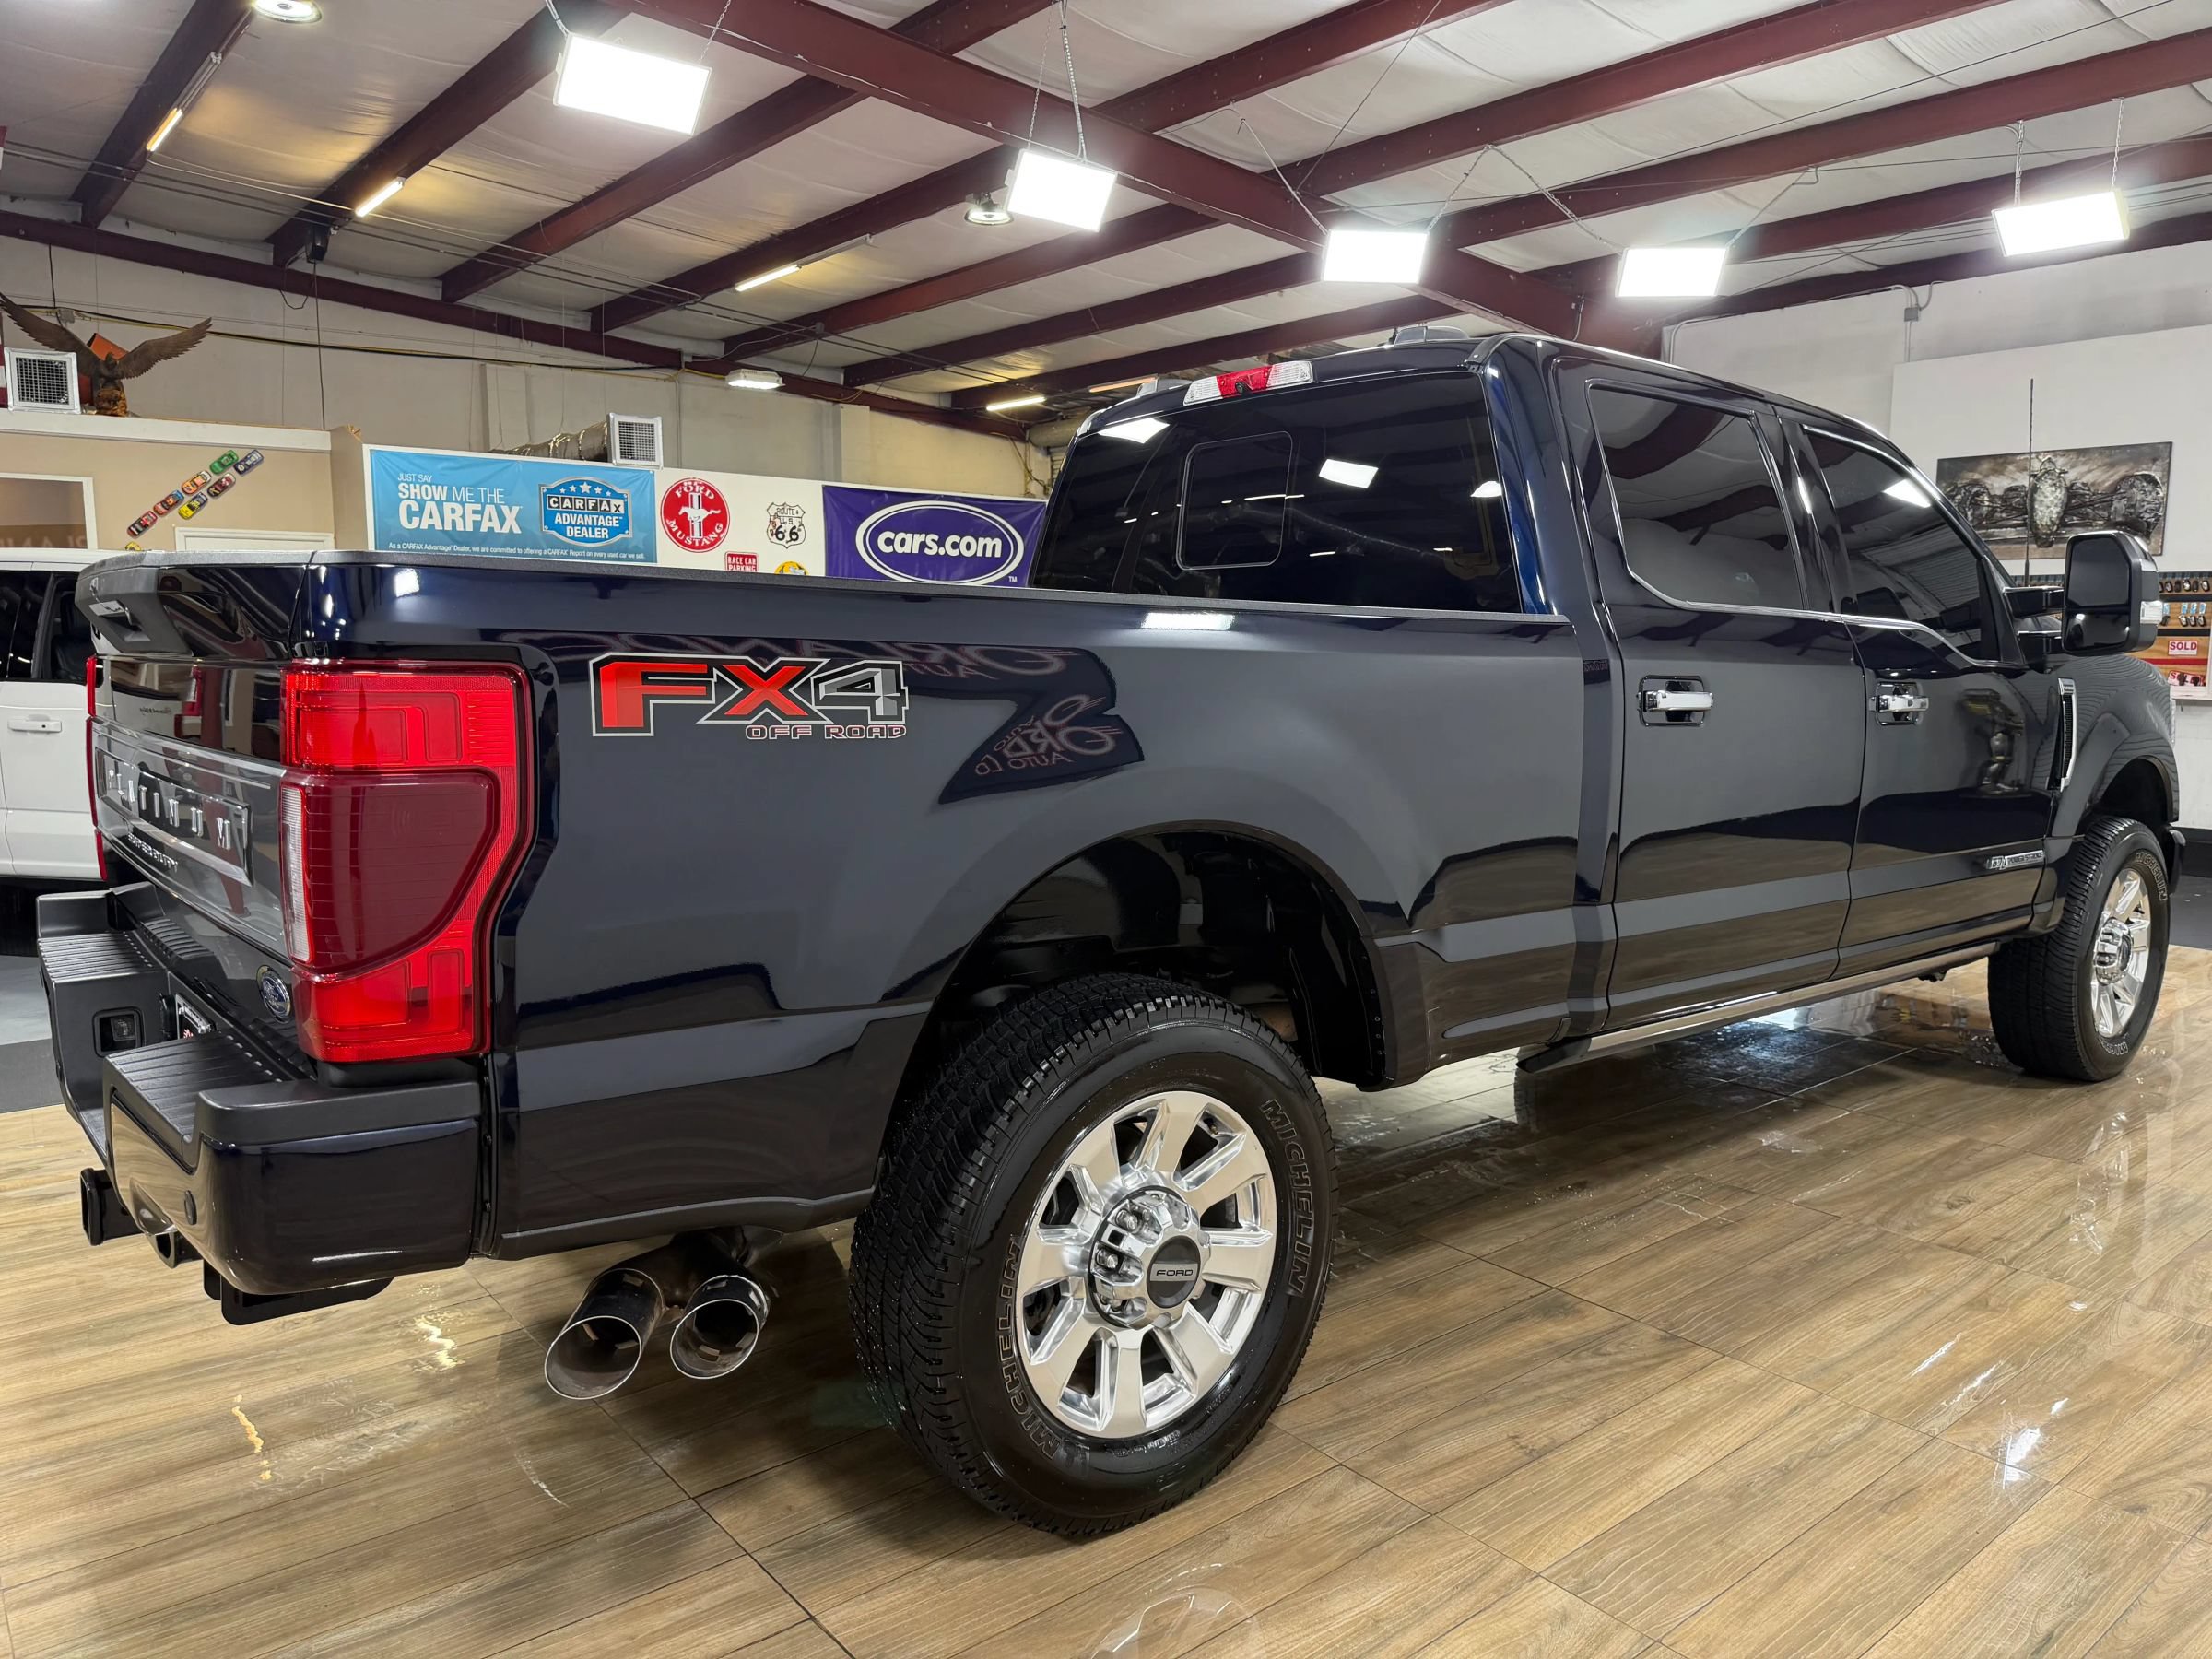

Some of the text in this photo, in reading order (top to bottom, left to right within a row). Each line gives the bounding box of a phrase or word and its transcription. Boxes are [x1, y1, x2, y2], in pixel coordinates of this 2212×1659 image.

[398, 473, 432, 483] JUST SAY
[398, 482, 505, 504] SHOW ME THE
[675, 484, 715, 500] FORD
[547, 495, 624, 513] CARFAX
[776, 507, 795, 516] ROUTE
[398, 499, 523, 534] CARFAX
[554, 512, 621, 527] ADVANTAGE
[566, 526, 609, 538] DEALER
[665, 518, 724, 547] MUSTANG
[775, 524, 799, 544] 66
[402, 542, 423, 551] CARFAX
[877, 531, 1003, 558] cars.com
[728, 556, 757, 565] RACE CAR
[728, 564, 757, 572] PARKING
[2170, 641, 2197, 651] SOLD
[590, 652, 908, 736] FX4
[746, 724, 907, 740] OFF ROAD
[108, 769, 231, 851] PLATINUM
[1261, 1099, 1314, 1297] MICHELIN
[998, 1237, 1061, 1460] MICHELIN
